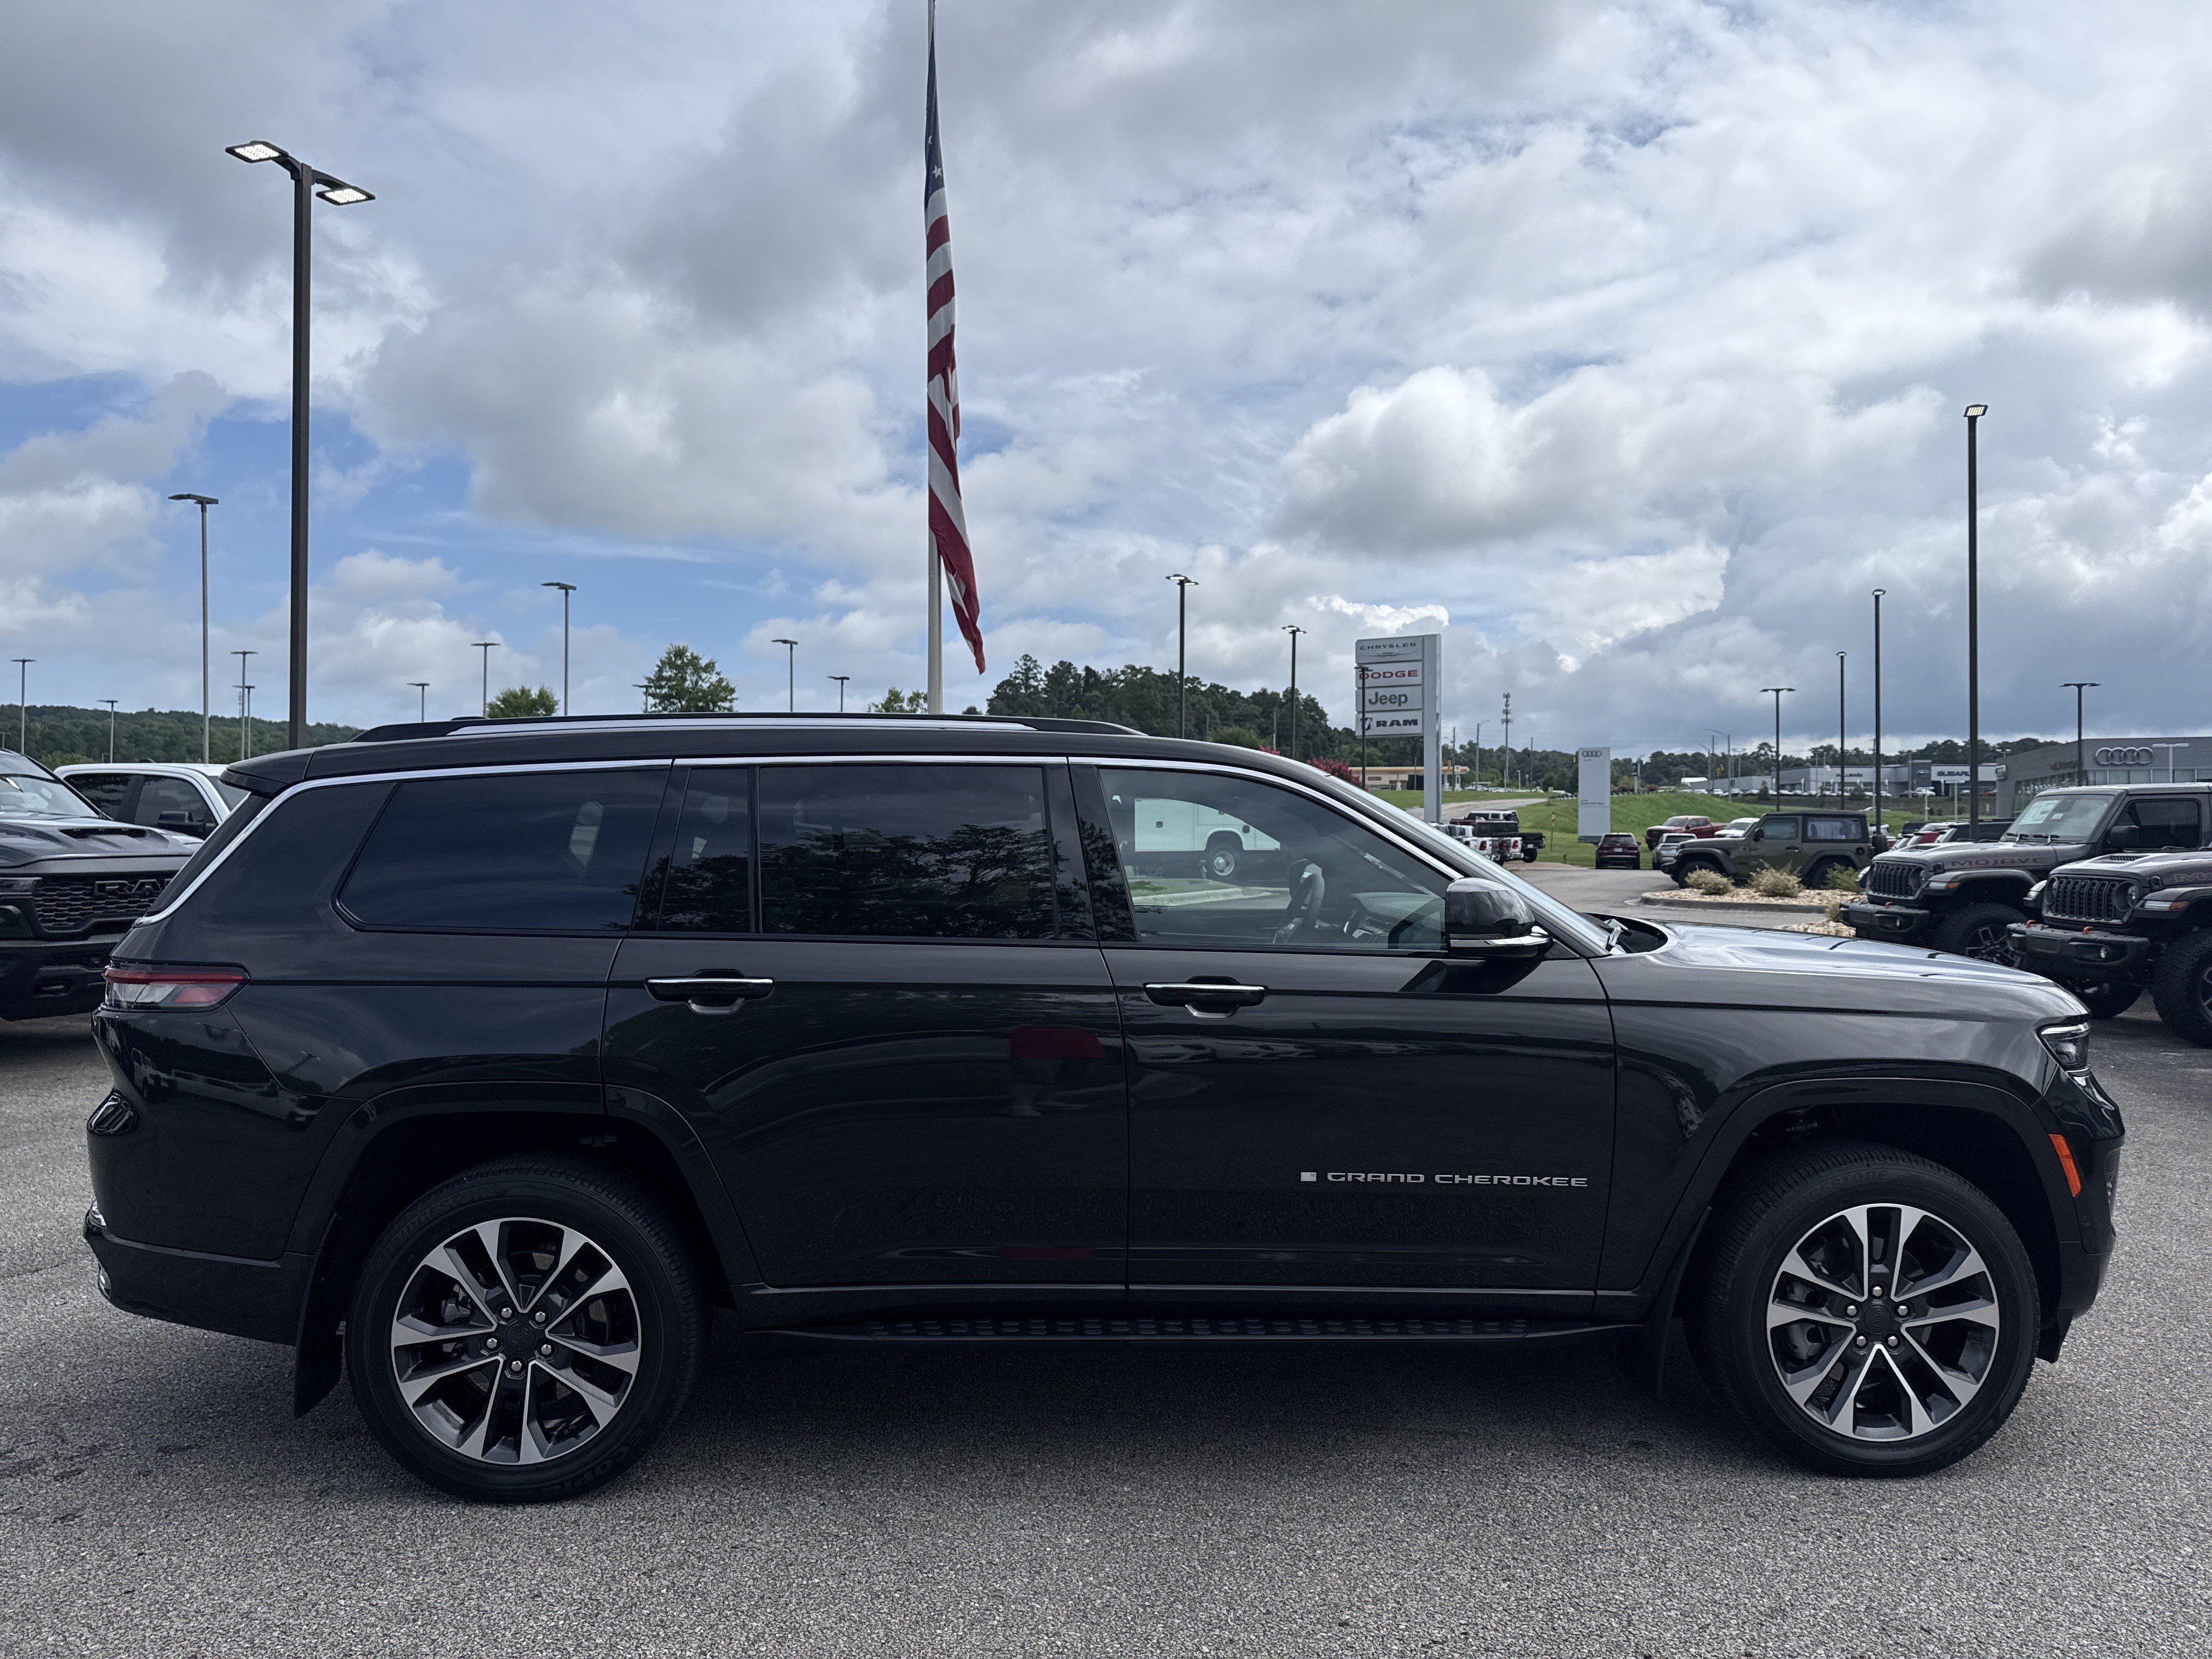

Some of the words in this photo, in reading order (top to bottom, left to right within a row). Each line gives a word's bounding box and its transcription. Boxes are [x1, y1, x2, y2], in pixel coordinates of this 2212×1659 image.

[1359, 670, 1418, 680] DODGE
[1368, 691, 1408, 707] Jeep
[1376, 719, 1418, 727] RAM
[1951, 857, 2046, 867] MOJAVE
[94, 878, 173, 896] RA
[1327, 1172, 1425, 1183] GRAND
[1434, 1174, 1588, 1187] CHEROKEE
